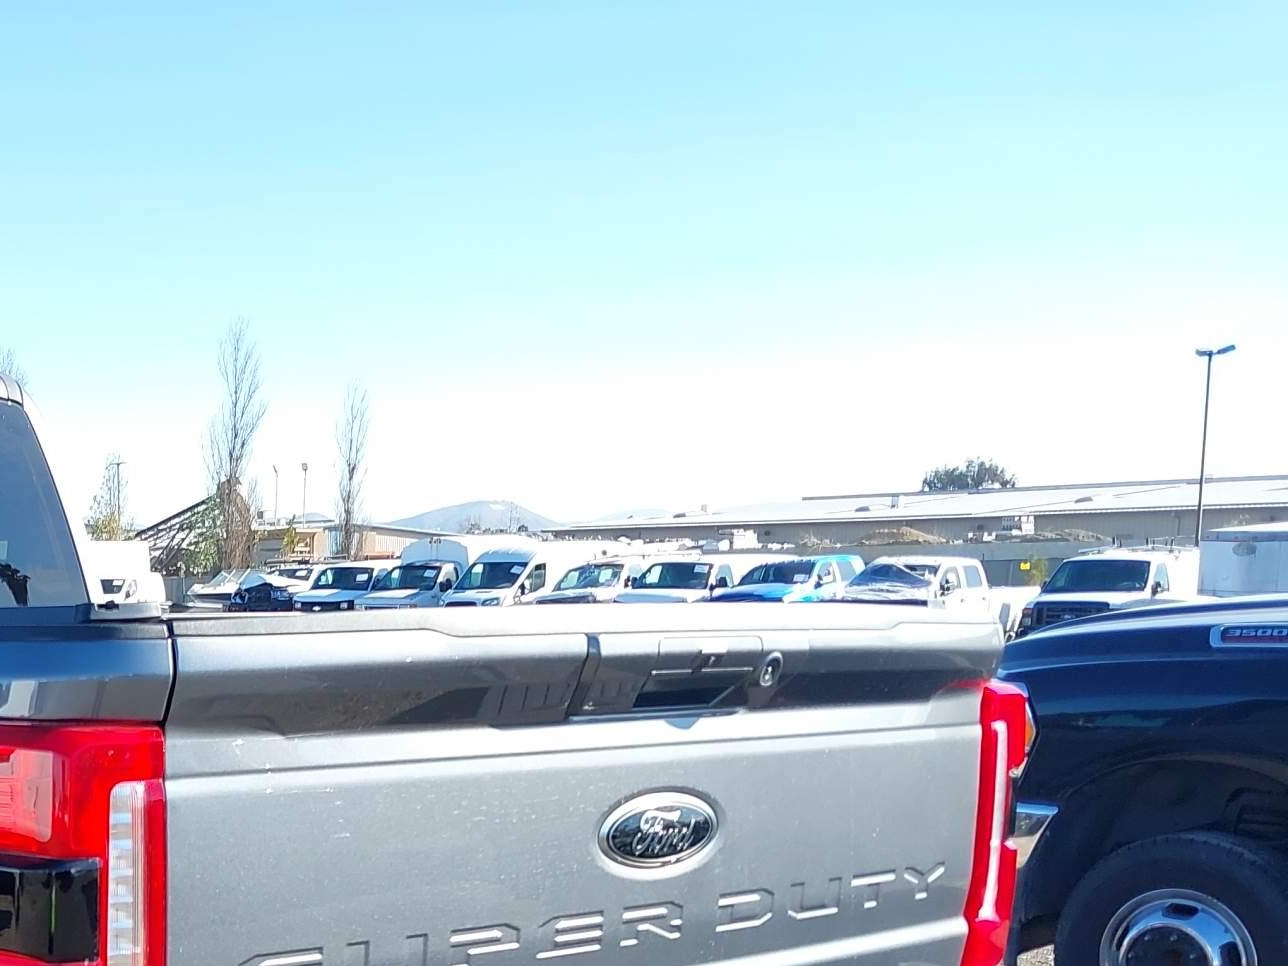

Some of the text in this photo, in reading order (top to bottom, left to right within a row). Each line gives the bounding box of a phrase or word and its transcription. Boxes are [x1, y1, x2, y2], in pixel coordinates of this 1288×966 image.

[1225, 628, 1288, 637] 3500
[631, 808, 697, 856] Ford
[715, 861, 945, 932] DUTY
